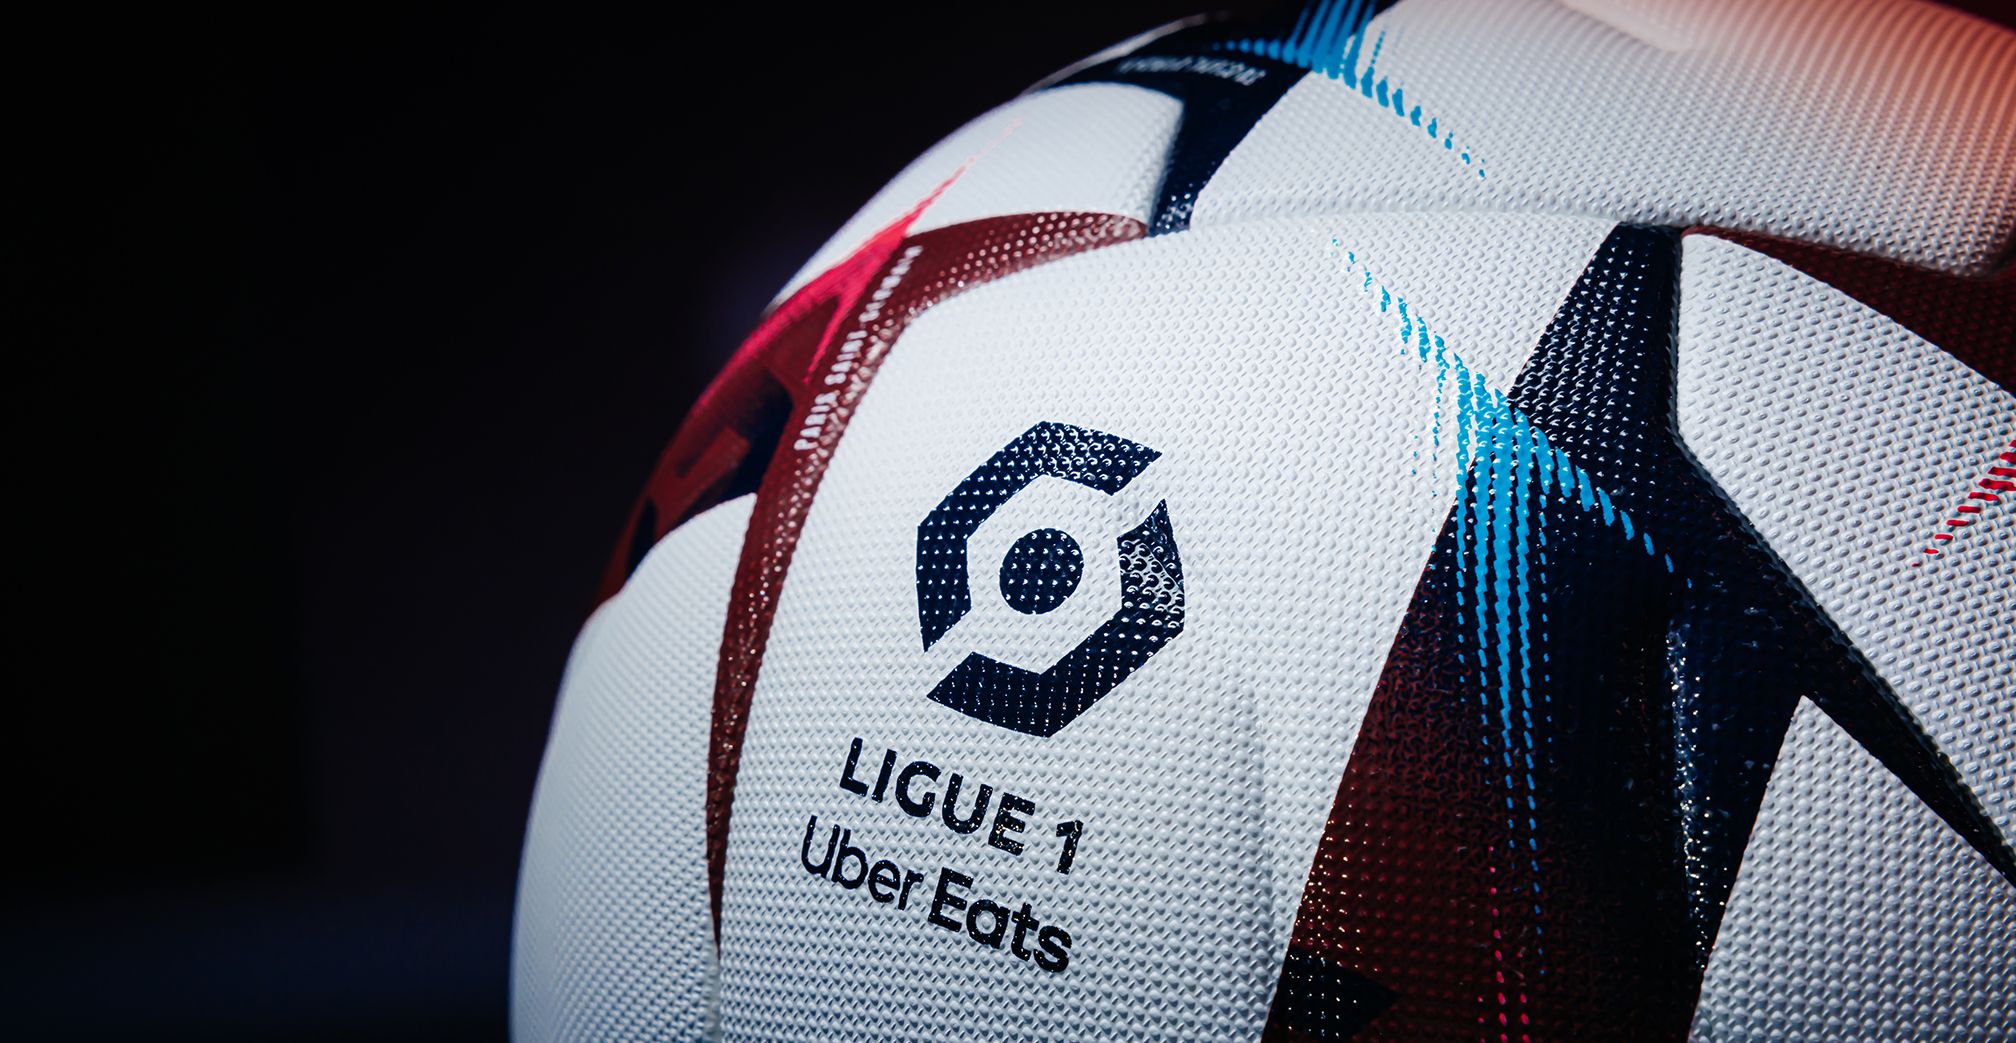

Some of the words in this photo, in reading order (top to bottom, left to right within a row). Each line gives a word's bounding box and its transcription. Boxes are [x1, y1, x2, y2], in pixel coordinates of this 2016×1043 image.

[794, 389, 839, 451] PARIS
[824, 330, 868, 386] SAINT
[839, 737, 1036, 856] LIGUE
[1055, 820, 1084, 875] 1
[801, 815, 924, 910] Uber
[927, 866, 1073, 973] Eats
